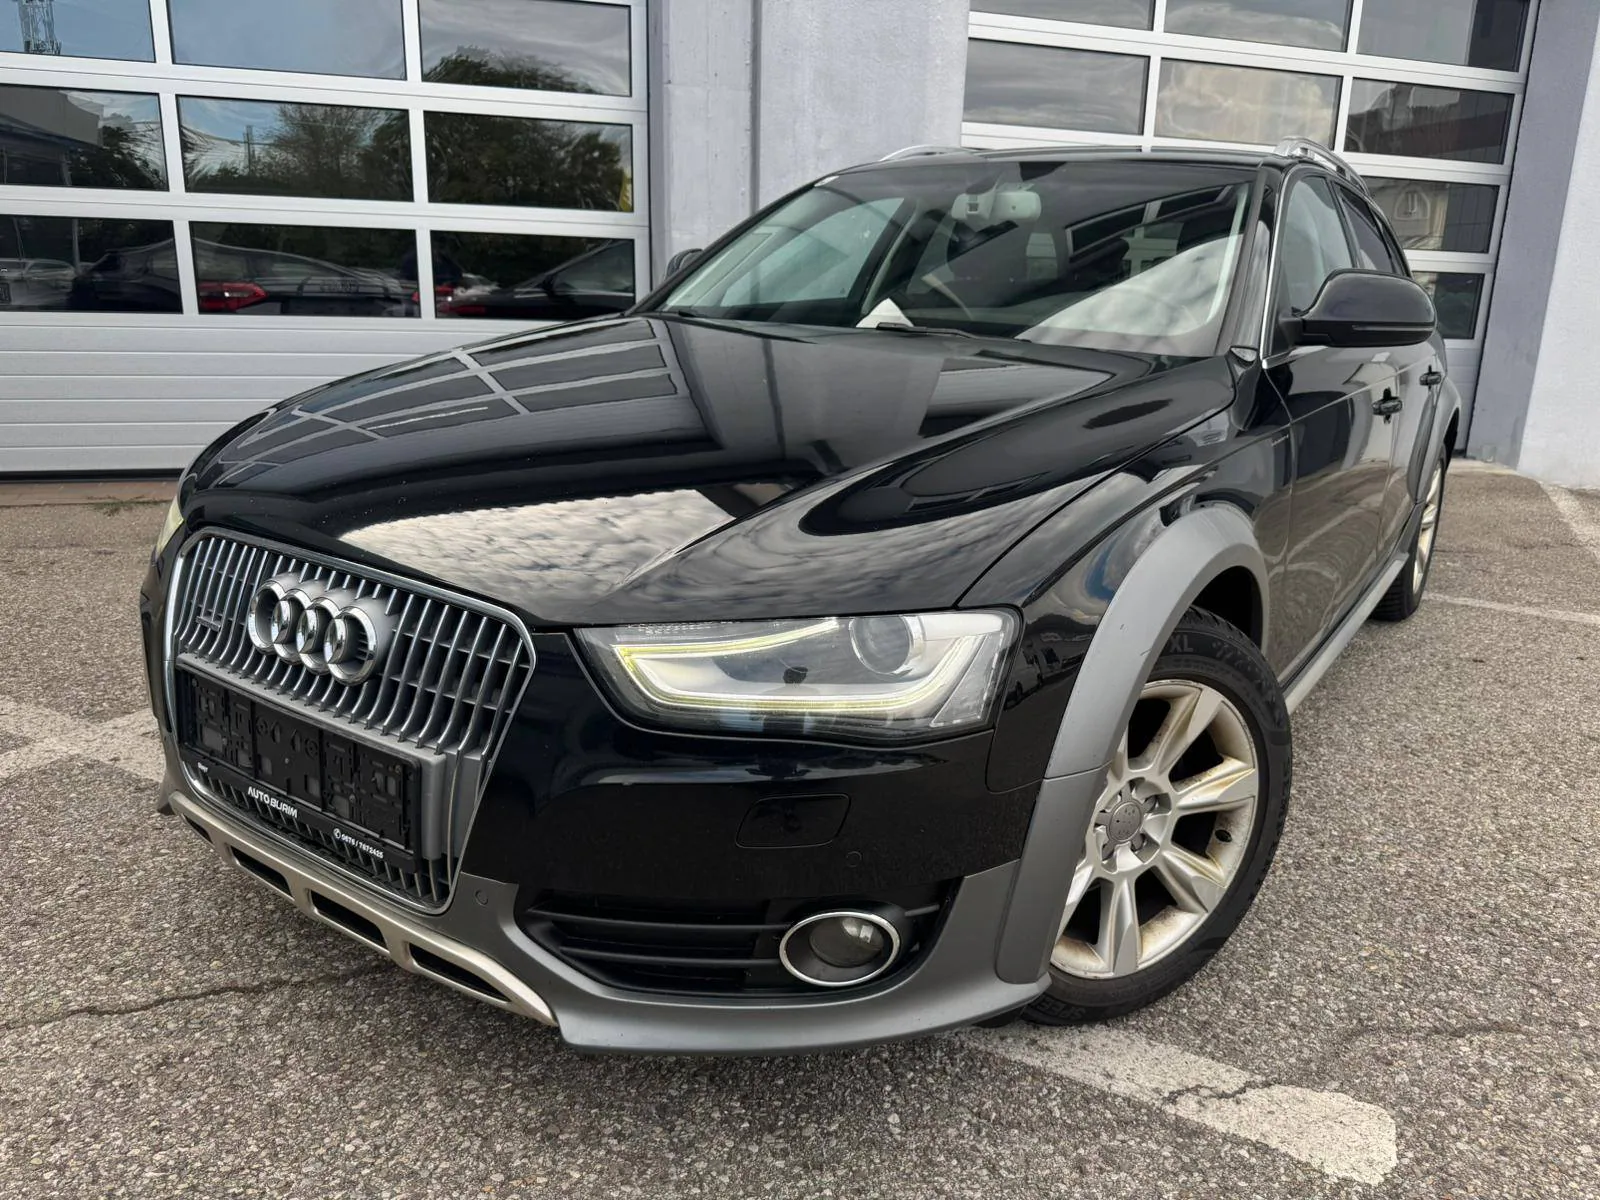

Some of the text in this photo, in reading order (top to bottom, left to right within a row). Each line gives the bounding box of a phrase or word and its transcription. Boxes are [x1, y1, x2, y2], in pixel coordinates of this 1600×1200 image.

[1170, 634, 1194, 653] XL
[247, 786, 298, 819] AUTO BURIM
